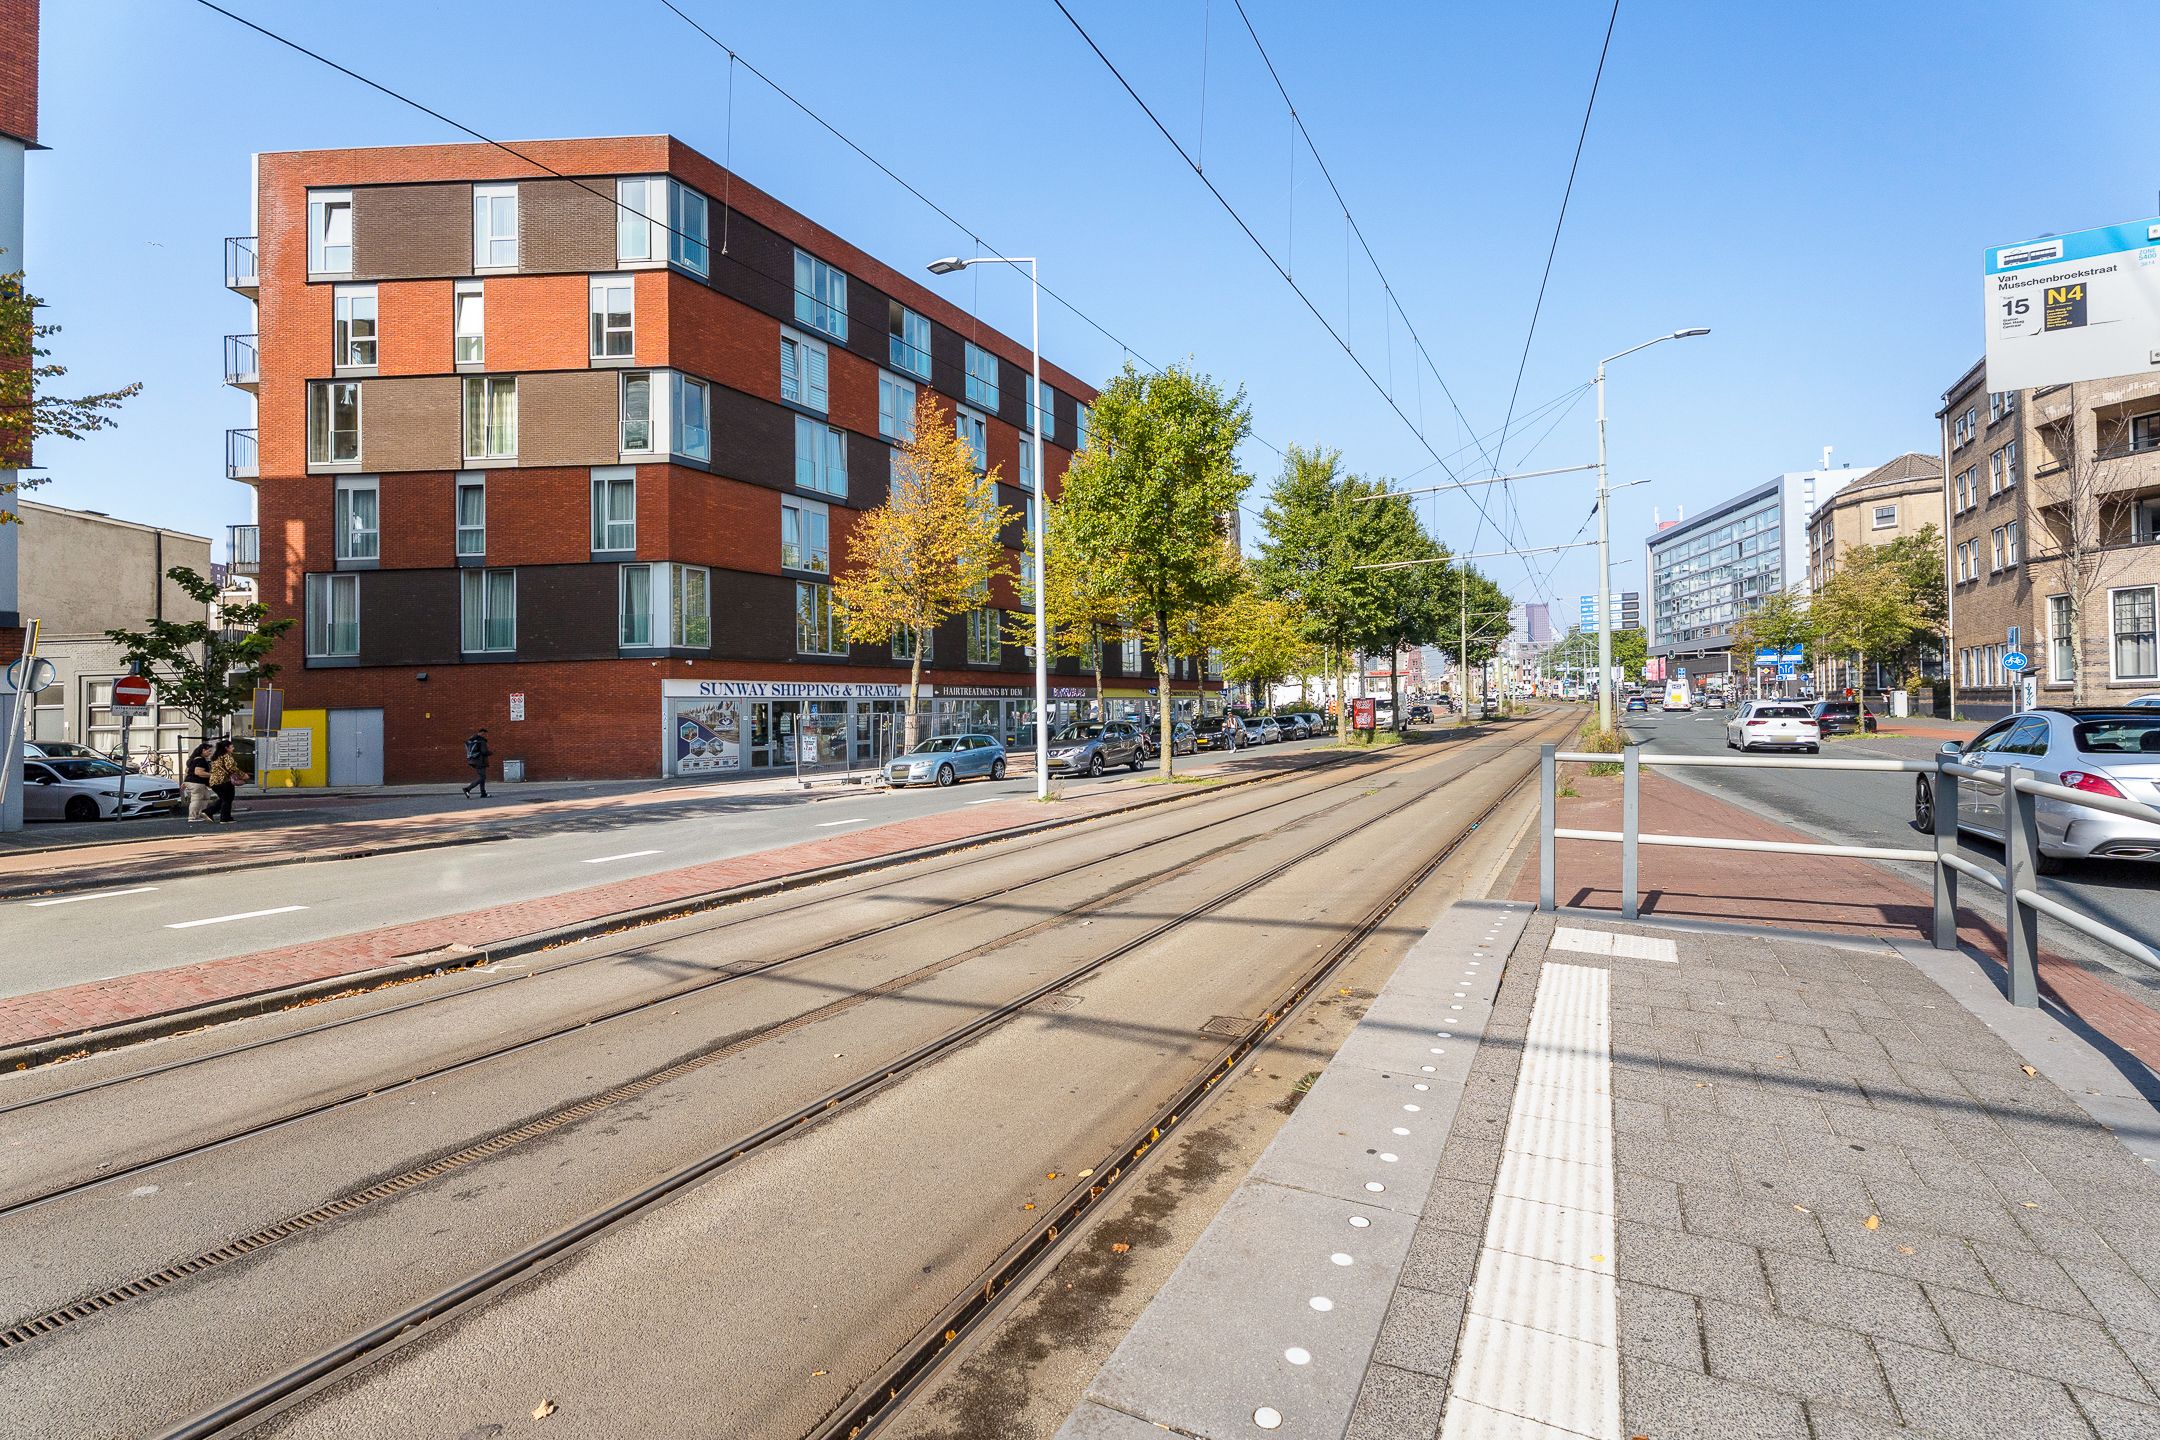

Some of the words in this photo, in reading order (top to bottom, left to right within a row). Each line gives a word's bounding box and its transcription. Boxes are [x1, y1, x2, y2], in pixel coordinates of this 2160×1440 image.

[1998, 264, 2118, 291] Musschenbroekstraat
[1998, 273, 2018, 283] Van
[2048, 284, 2084, 305] N4
[2002, 298, 2030, 316] 15
[700, 682, 767, 696] SUNWAY
[771, 683, 839, 697] SHIPPING
[842, 684, 854, 697] &
[856, 685, 902, 697] TRAVEL
[943, 687, 999, 696] HAIRTREATMENTS
[1000, 688, 1009, 696] BY
